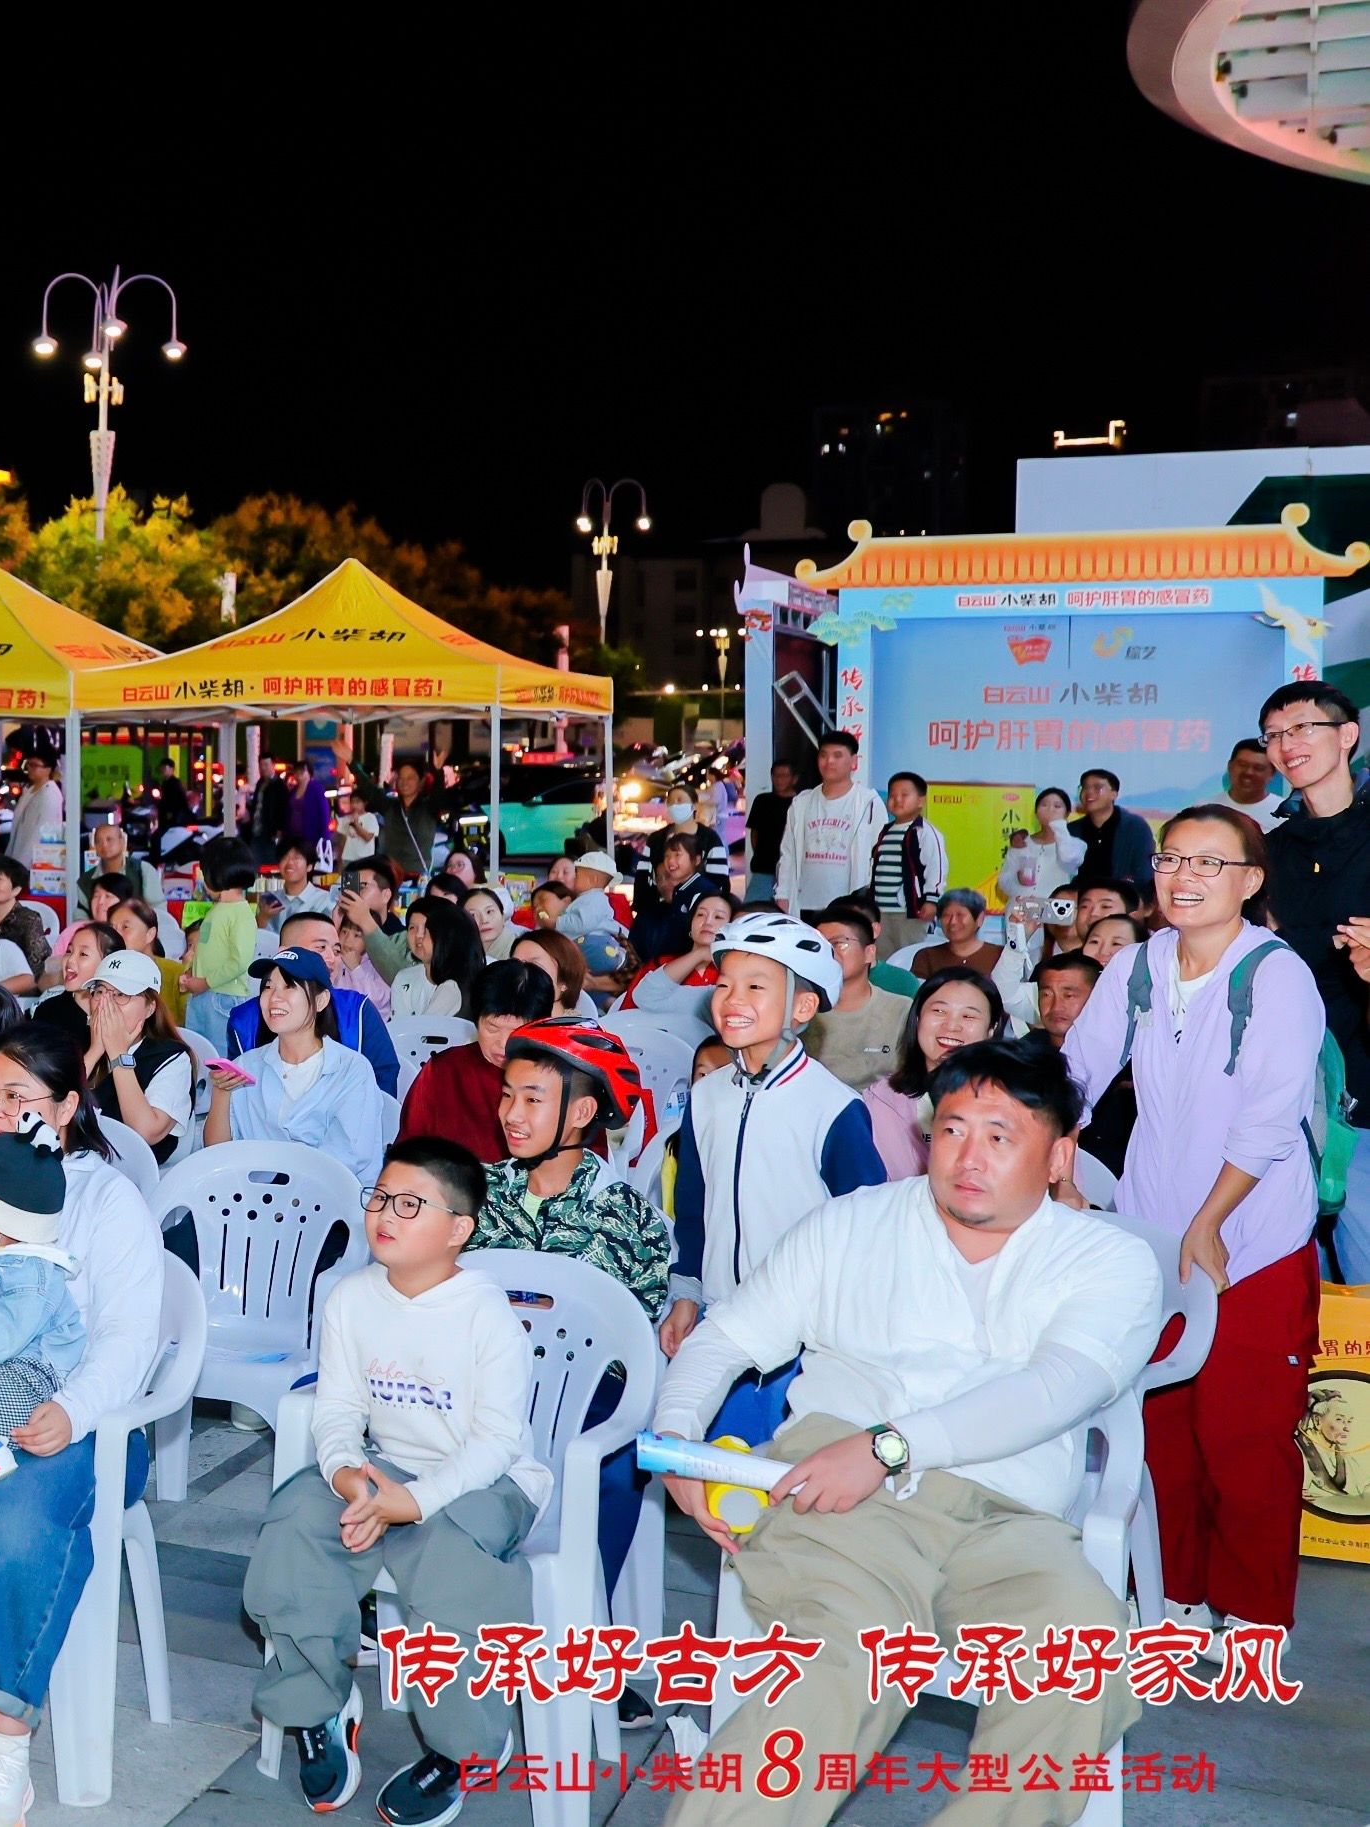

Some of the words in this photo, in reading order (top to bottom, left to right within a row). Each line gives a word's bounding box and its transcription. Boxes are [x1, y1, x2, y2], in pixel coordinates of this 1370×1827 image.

[957, 595, 996, 608] 白云山
[1000, 593, 1056, 607] 小柴胡
[1067, 588, 1210, 606] 呵护肝胃的感冒药
[290, 627, 406, 643] 小柴胡
[122, 684, 171, 703] 白云山
[263, 676, 443, 698] 呵护肝胃的感冒药!
[983, 685, 1050, 705] 白云山
[1059, 681, 1159, 706] 小柴胡
[928, 718, 1211, 752] 呵护肝胃的感冒药
